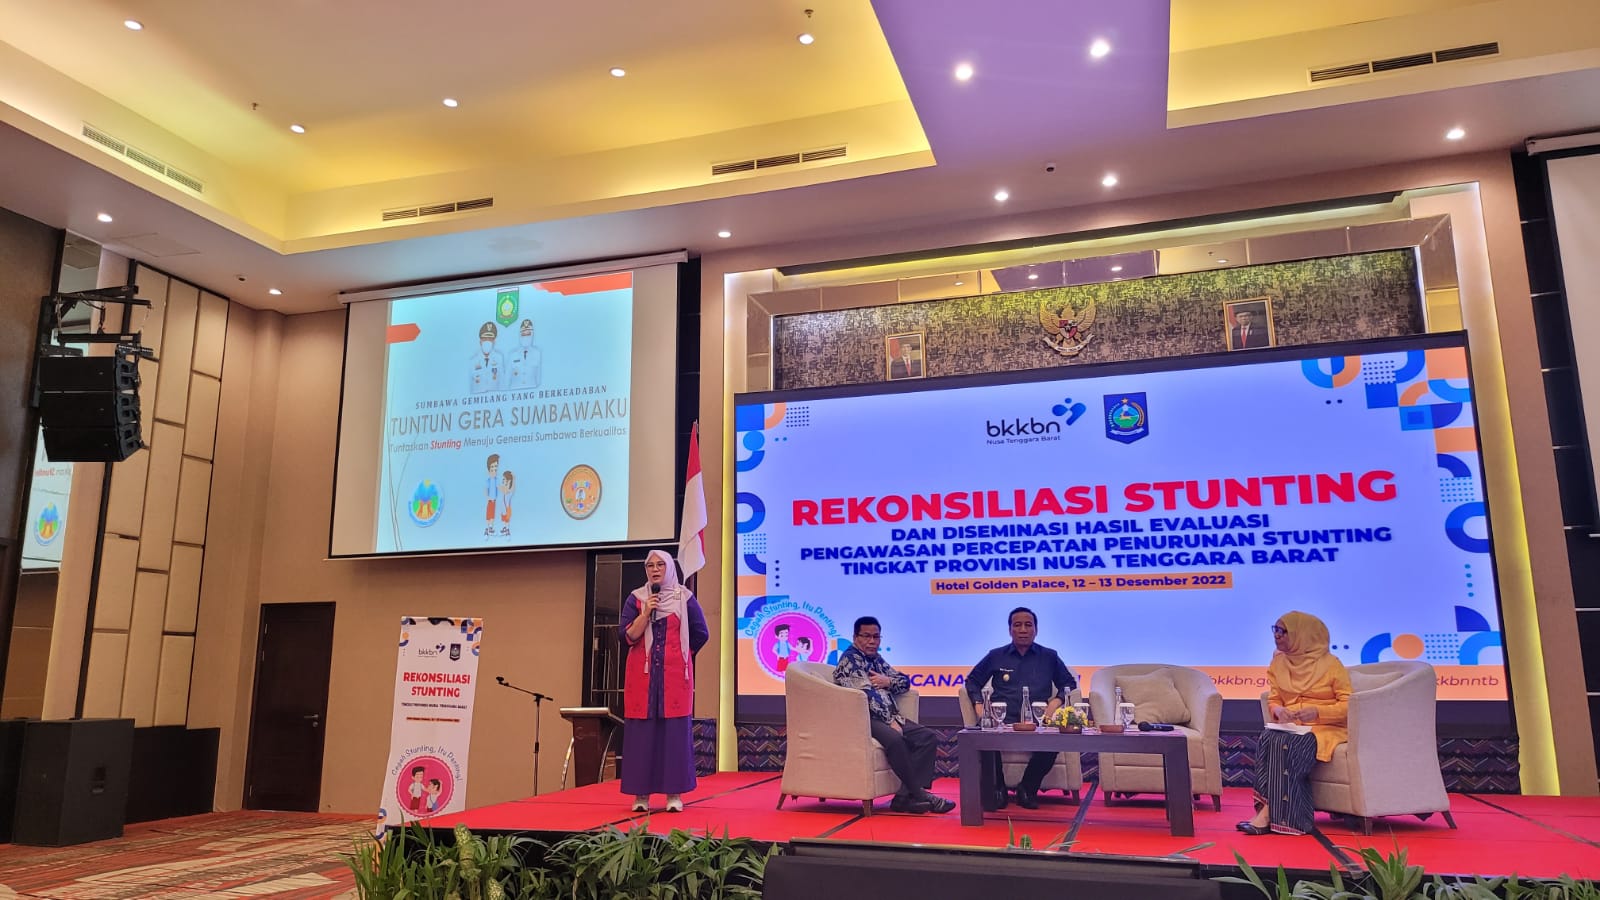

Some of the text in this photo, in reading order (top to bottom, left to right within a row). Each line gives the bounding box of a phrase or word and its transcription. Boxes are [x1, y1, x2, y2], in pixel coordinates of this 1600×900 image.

[415, 385, 607, 410] SUMBAWA GEMILANG YANG BERKEADABAN
[391, 398, 627, 436] TUNTUN GERA SUMBAWAKU
[986, 417, 1061, 437] bkkbn
[389, 426, 627, 453] Tuntaskan Stunting Menuju Generasi Sumbawa Berkualitas
[792, 470, 1397, 526] REKONSILIASI STUNTING
[891, 514, 1270, 542] DAN DISEMINASI HASIL EVALUASI
[800, 526, 1393, 561] PENGAWASAN PERCEPATAN PENURUNAN STUNTING
[841, 547, 1340, 576] TINGKAT PROVINSI NUSA TENGGARA BARAT
[935, 581, 970, 592] Hotel
[973, 579, 1019, 591] Golden
[1022, 577, 1070, 591] Palace,
[1073, 577, 1086, 588] 12
[1099, 577, 1113, 588] 13
[1116, 575, 1188, 588] Desember
[1191, 574, 1227, 586] 2022
[745, 601, 841, 638] Cegah Stunting, Itu Penting!
[418, 648, 438, 656] bkkbn
[403, 671, 471, 685] REKONSILIASI
[411, 686, 460, 698] STUNTING
